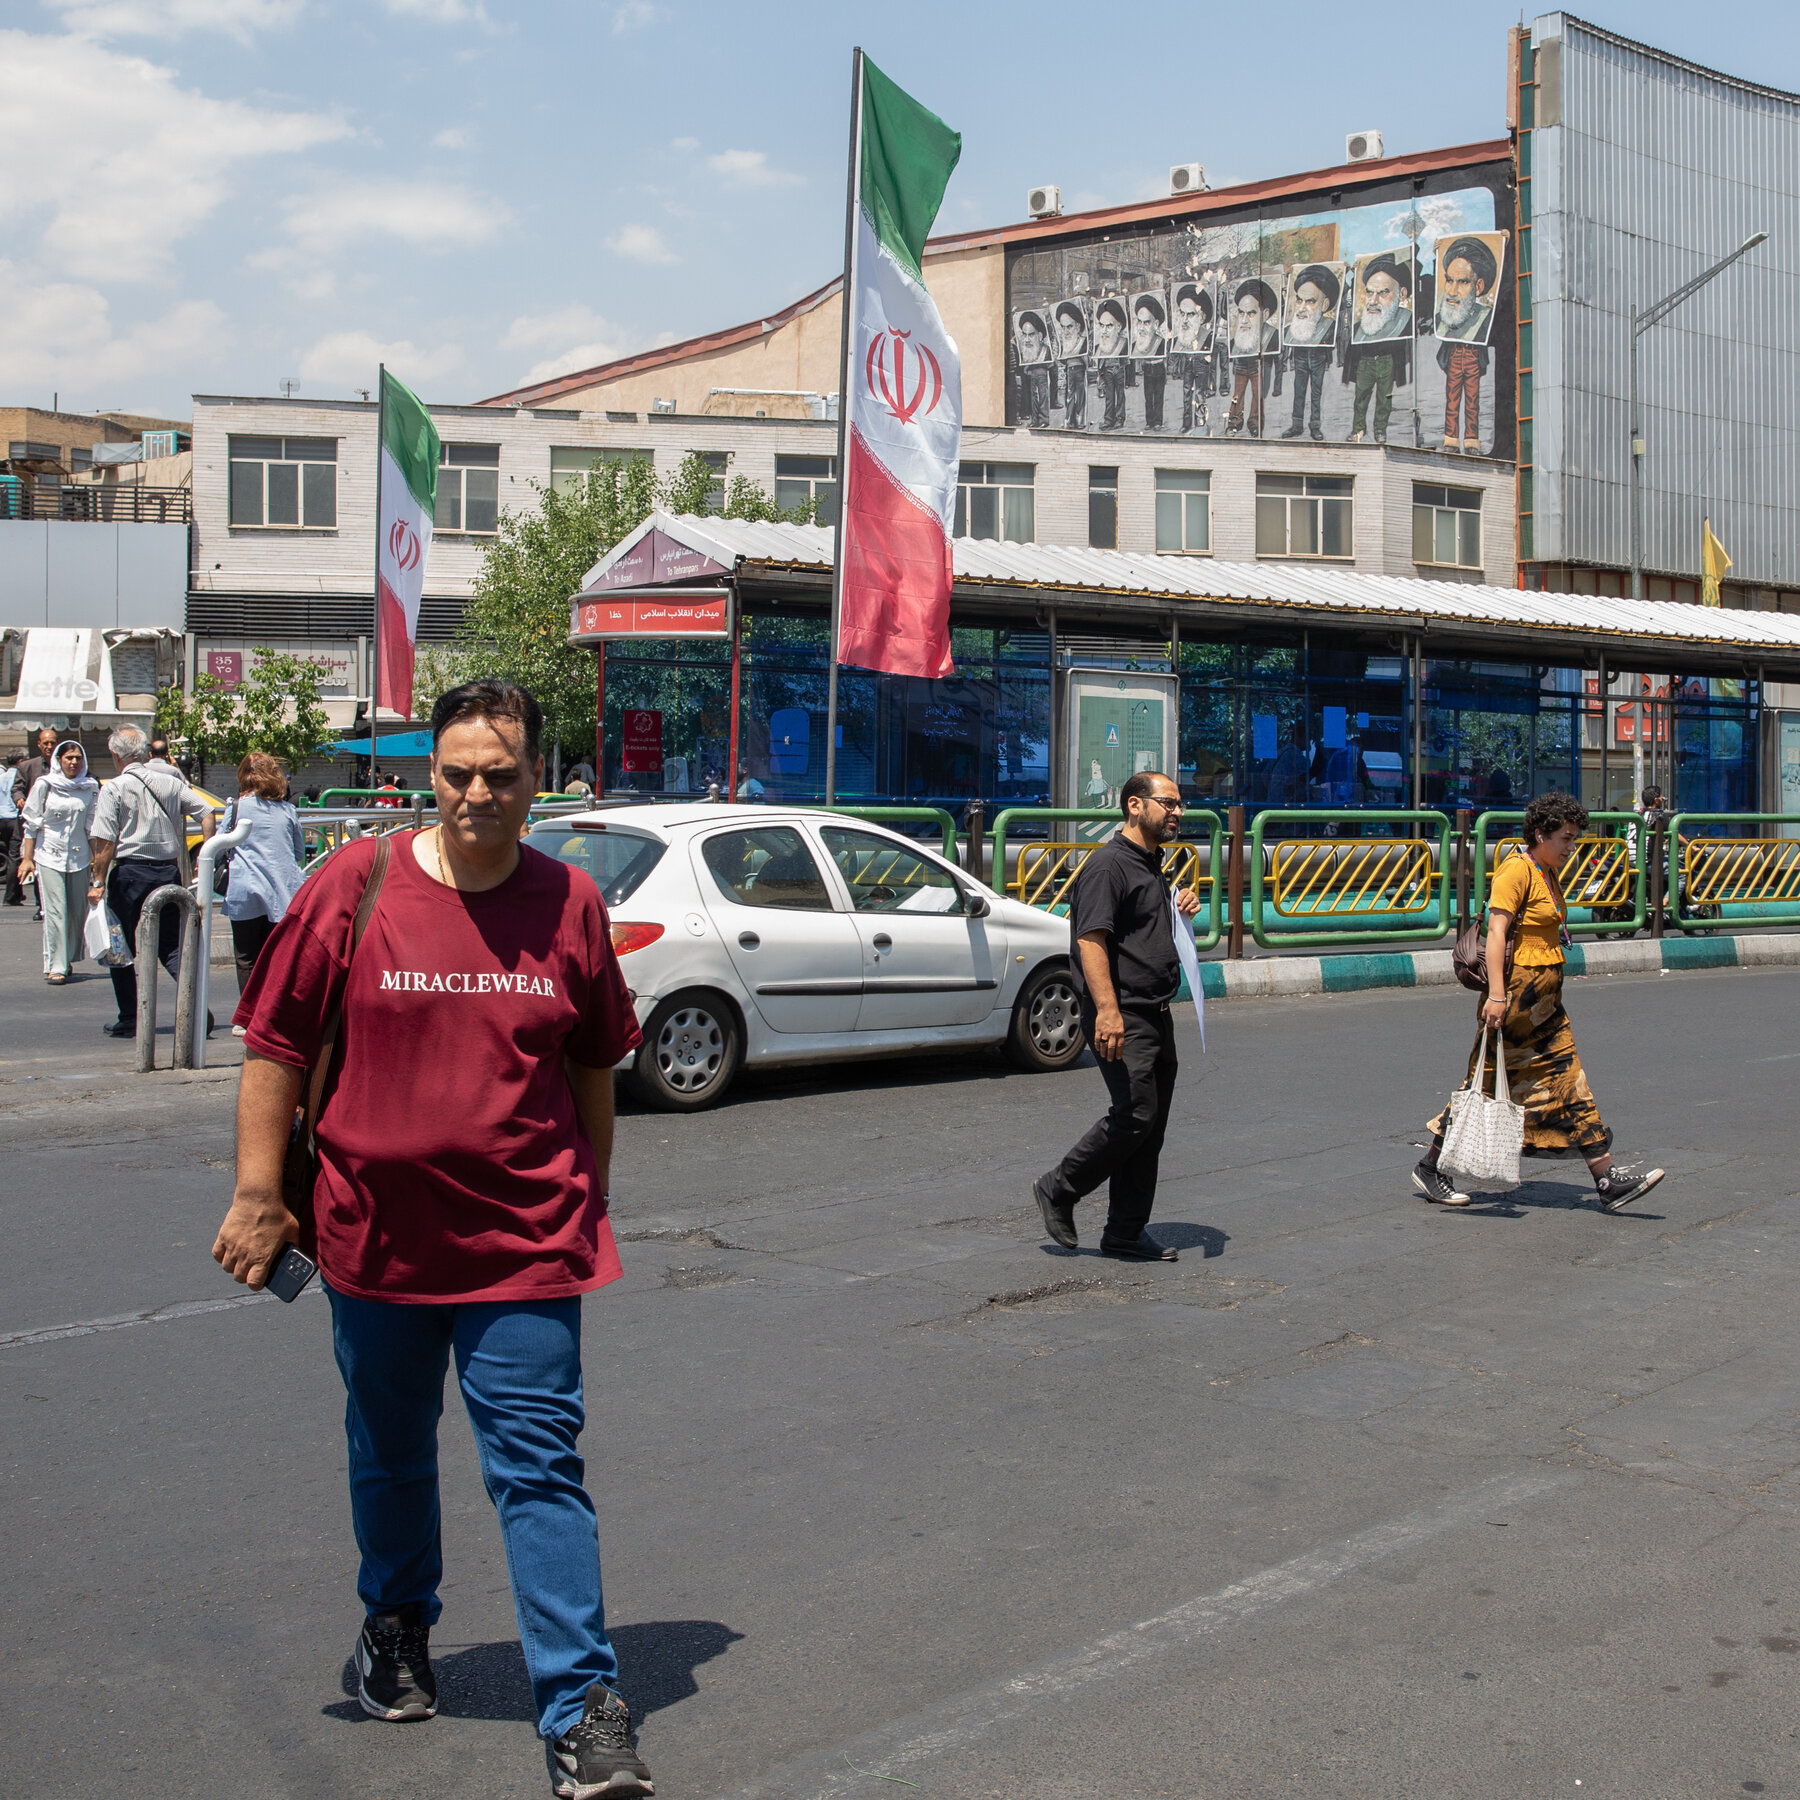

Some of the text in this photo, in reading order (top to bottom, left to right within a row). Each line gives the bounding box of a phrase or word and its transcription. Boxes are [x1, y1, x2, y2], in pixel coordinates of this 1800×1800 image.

[667, 564, 699, 576] To Tehranpars
[640, 608, 720, 620] میدان انقلاب اسلامی
[215, 656, 233, 665] 35
[379, 970, 556, 998] MIRACLEWEAR
